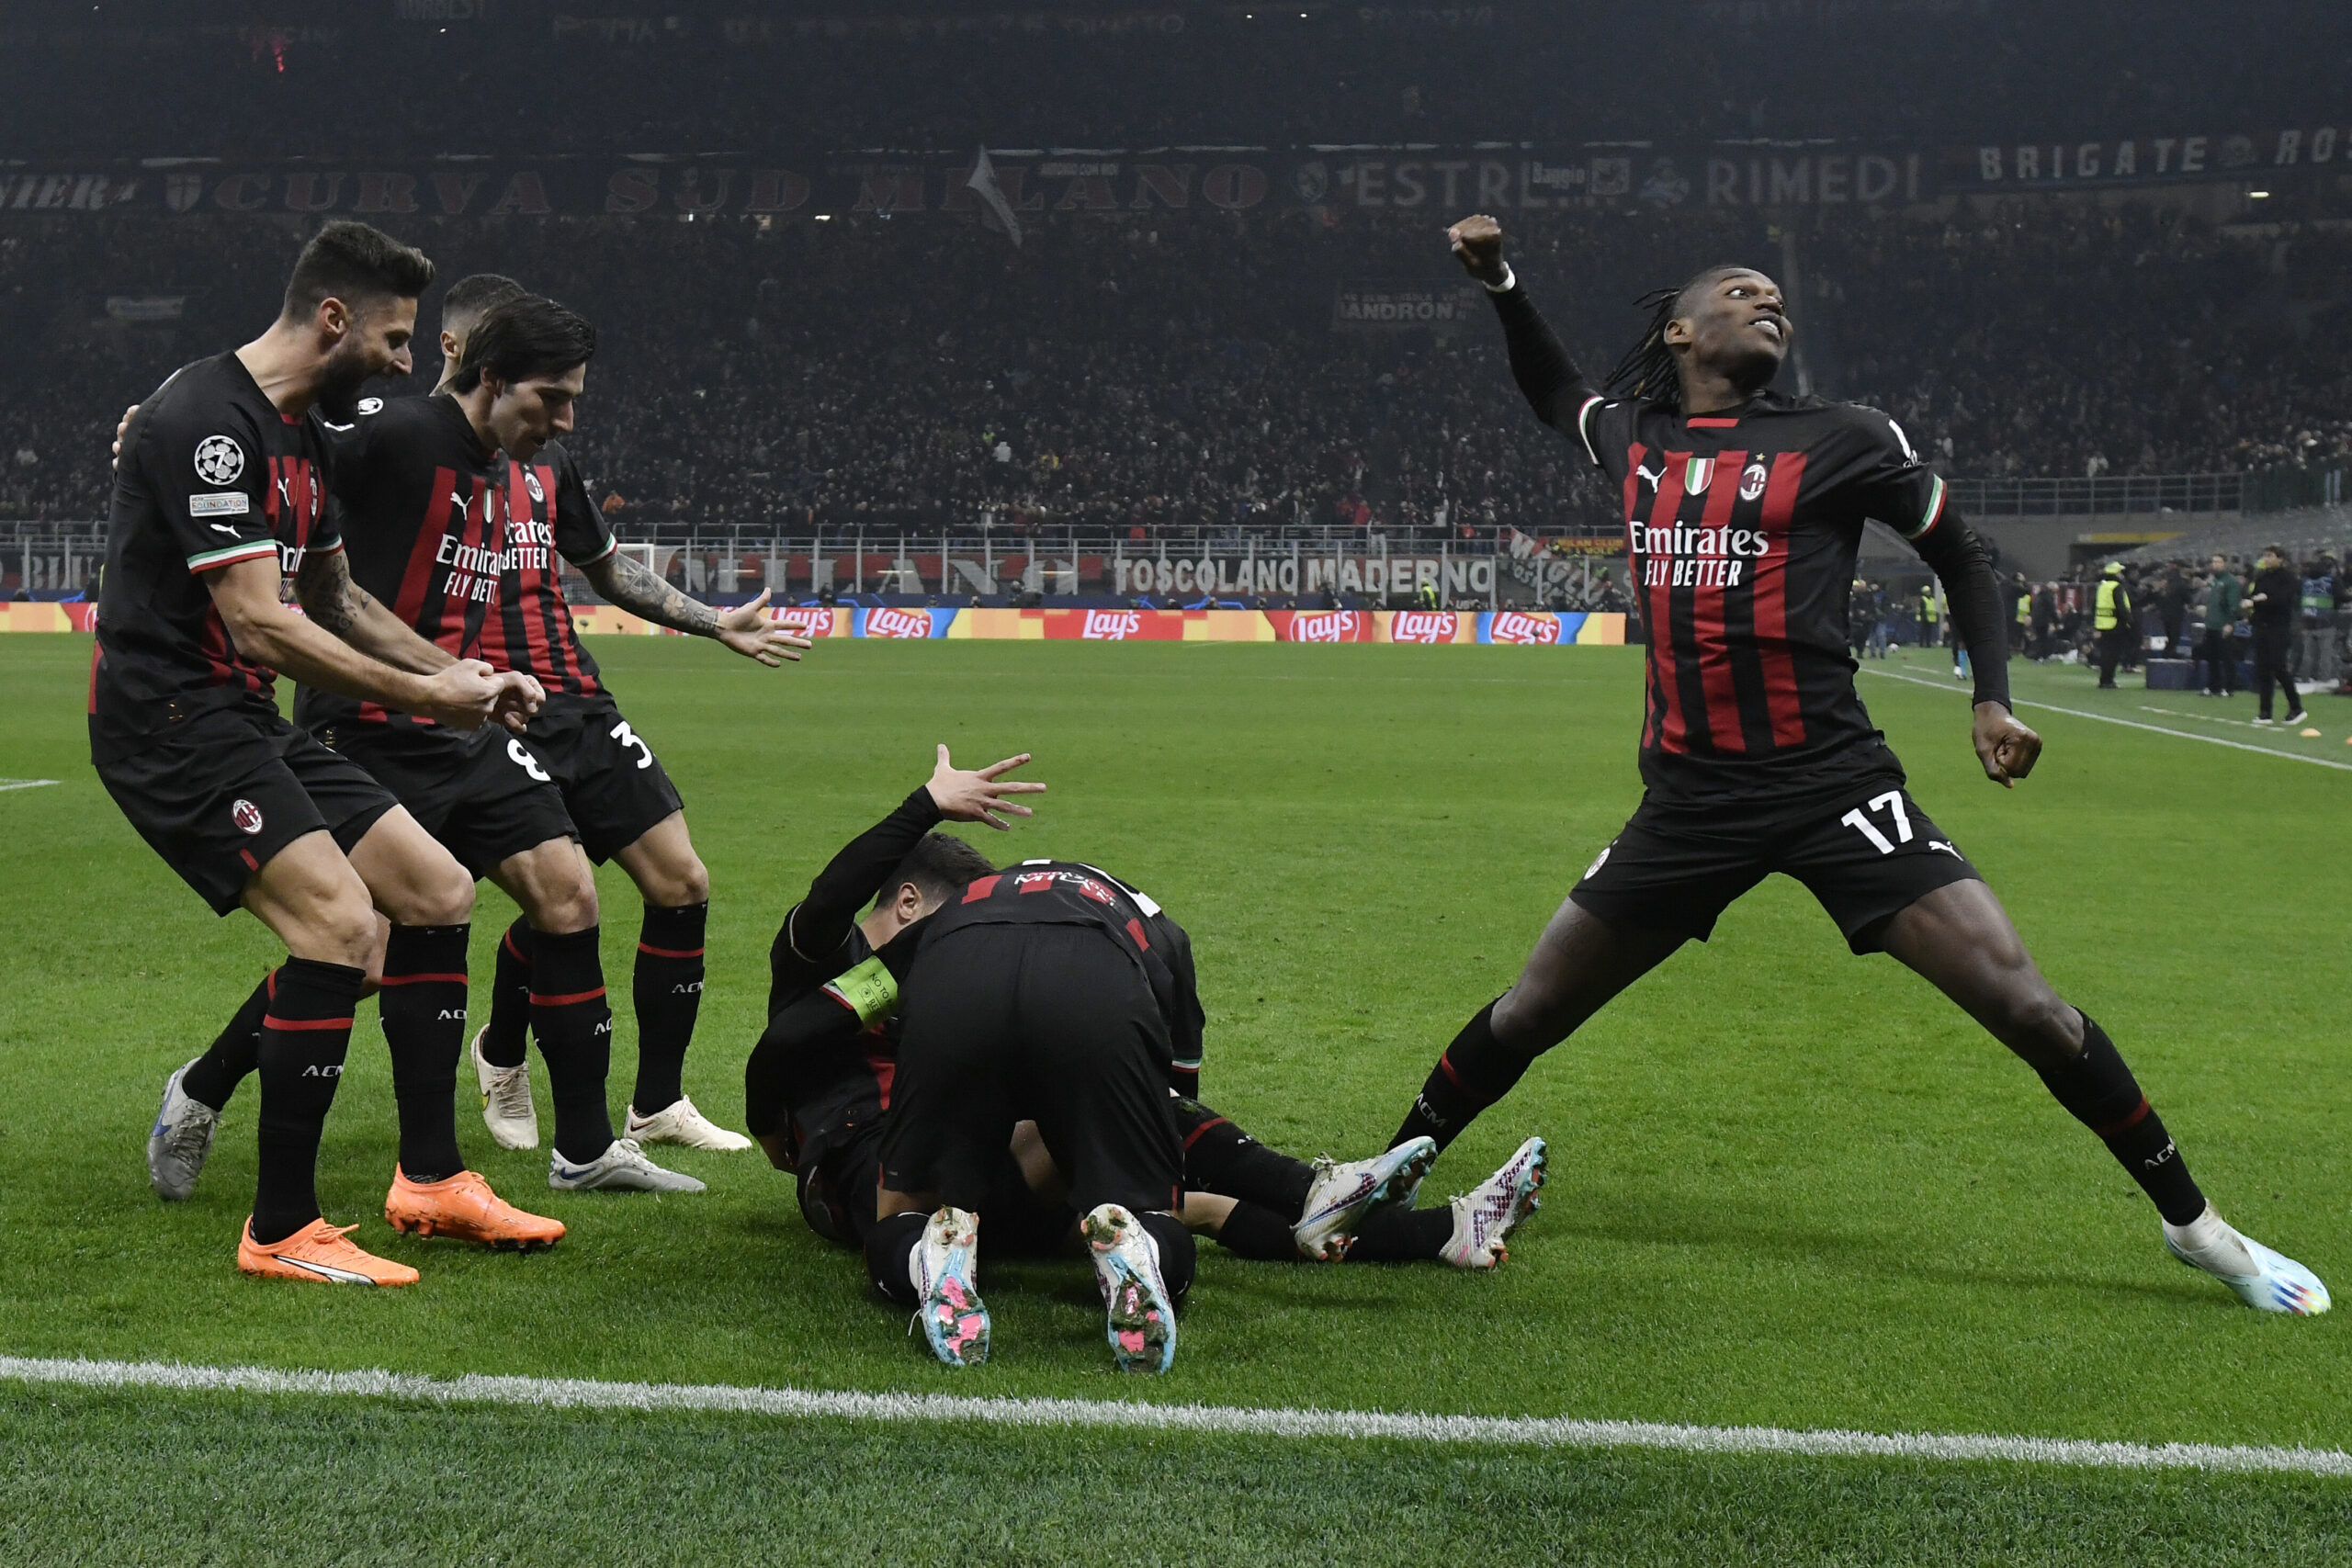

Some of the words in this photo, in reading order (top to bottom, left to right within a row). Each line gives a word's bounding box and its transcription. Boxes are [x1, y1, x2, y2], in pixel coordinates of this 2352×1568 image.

[1979, 135, 2208, 180] BRIGATE
[2274, 125, 2352, 164] RO
[212, 172, 552, 214] CURVA
[604, 168, 811, 213] SUD
[1706, 152, 1922, 207] RIMEDI
[191, 499, 247, 509] FOUNDATION
[1628, 520, 1770, 556] Emirates
[443, 570, 472, 598] FLY
[1114, 558, 1298, 593] TOSCOLANO
[1306, 558, 1492, 594] MADERNO
[1644, 559, 1669, 586] FLY
[1671, 559, 1743, 587] BETTER
[867, 608, 930, 638] Lay's
[1082, 610, 1141, 640] Lay's
[1297, 609, 1354, 641] Lay's
[1395, 611, 1454, 643] Lay's
[1494, 611, 1555, 644] Lay's
[506, 738, 551, 782] 8
[1840, 789, 1914, 855] 17
[869, 972, 882, 987] NO
[879, 986, 889, 999] TO
